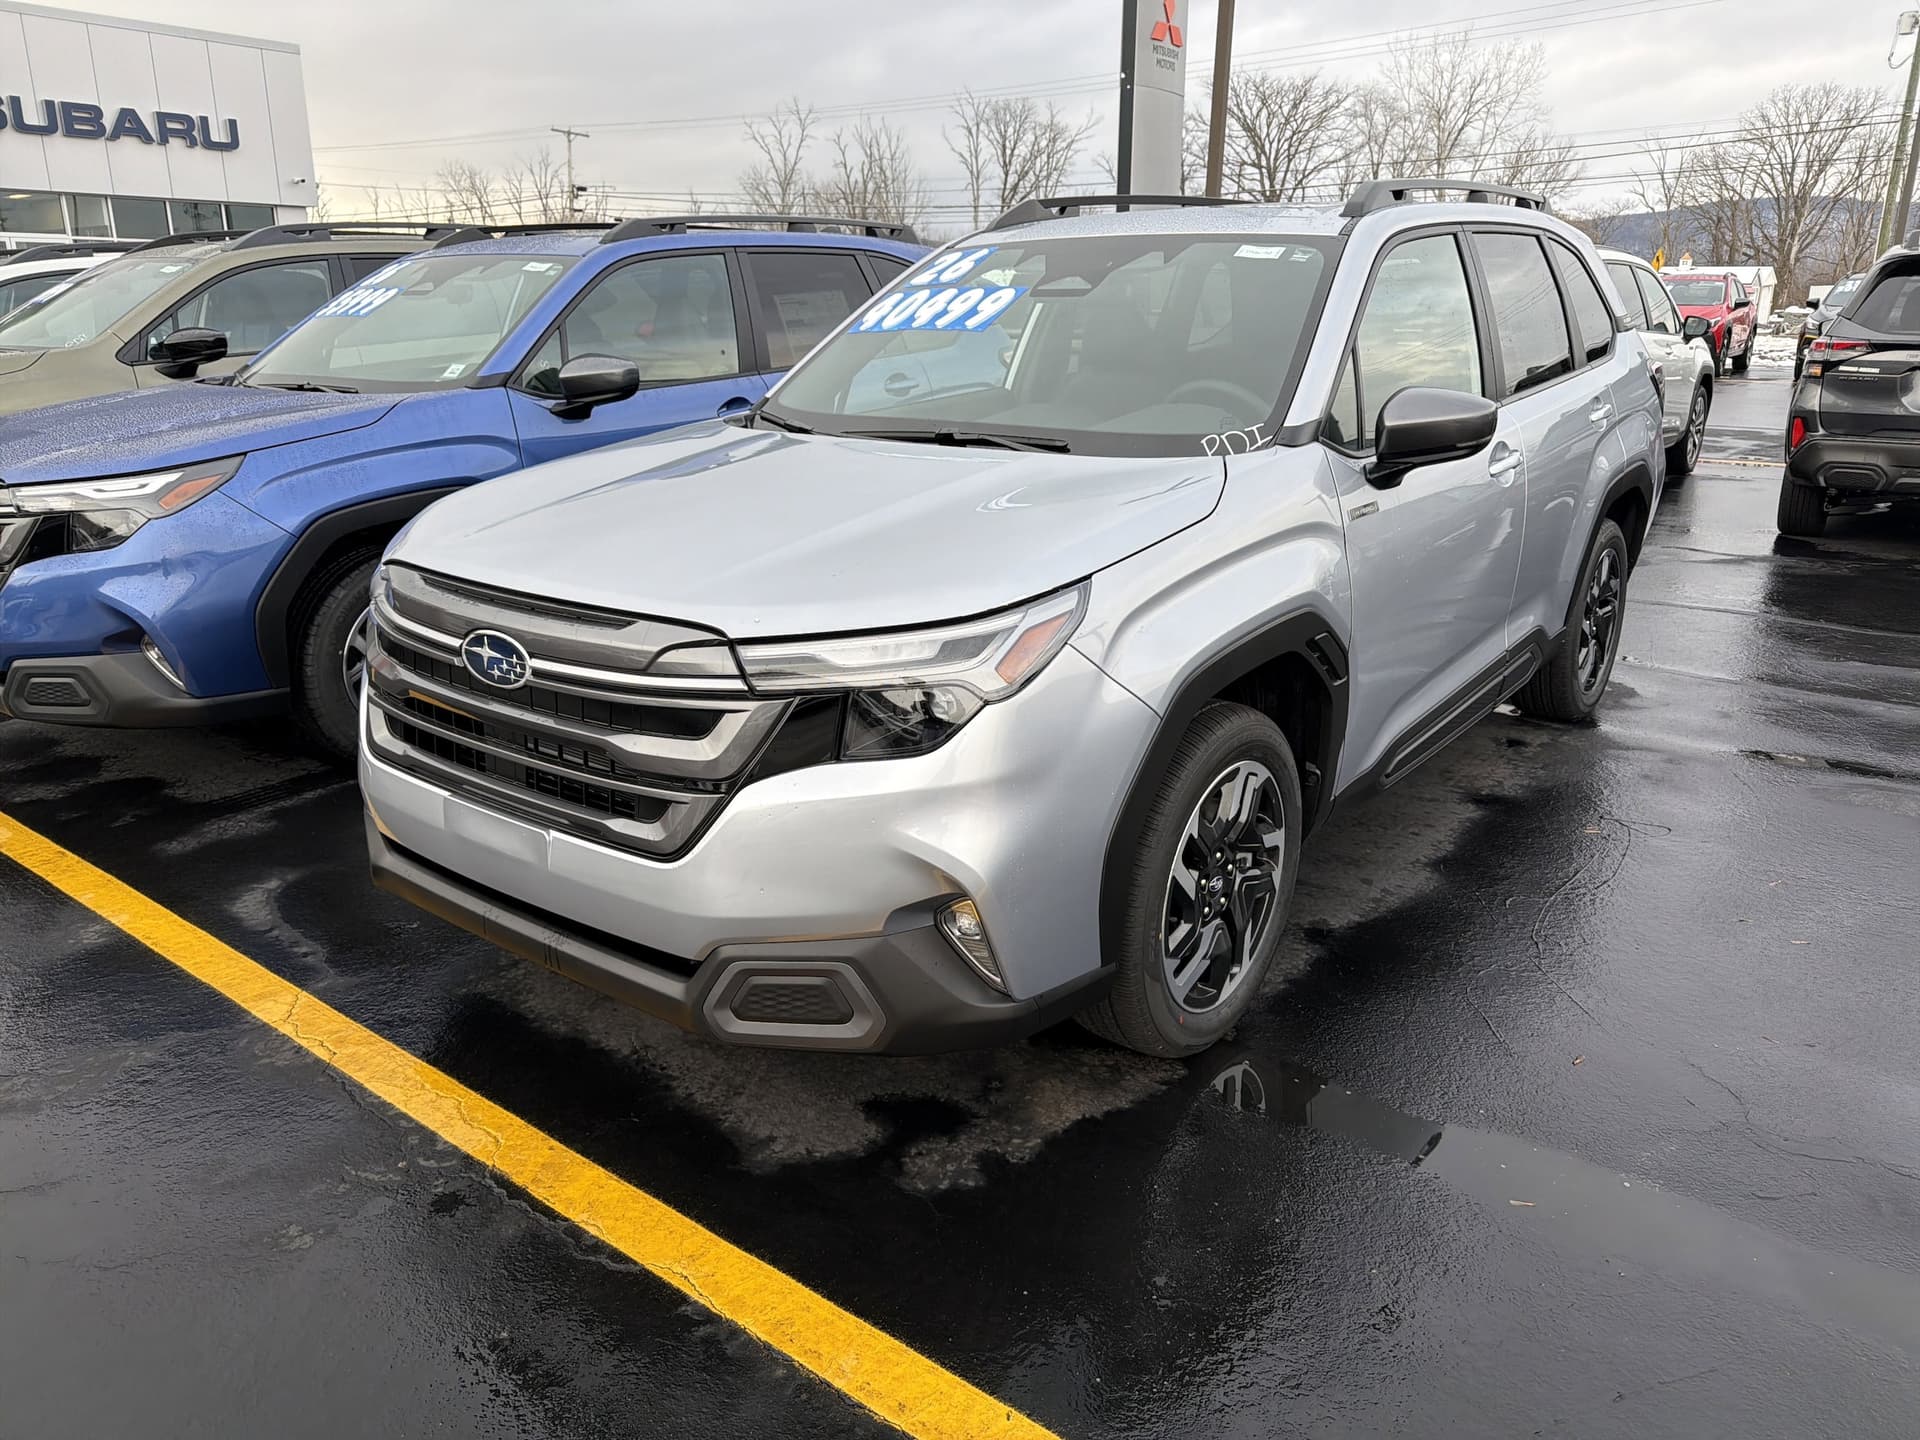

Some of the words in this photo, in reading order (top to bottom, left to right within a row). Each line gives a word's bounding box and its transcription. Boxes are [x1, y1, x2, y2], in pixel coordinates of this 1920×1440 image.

[1155, 57, 1176, 72] MOTORS
[0, 95, 240, 151] UBARU
[909, 248, 990, 286] 26
[859, 287, 1016, 332] 40499
[1200, 422, 1274, 457] PDI
